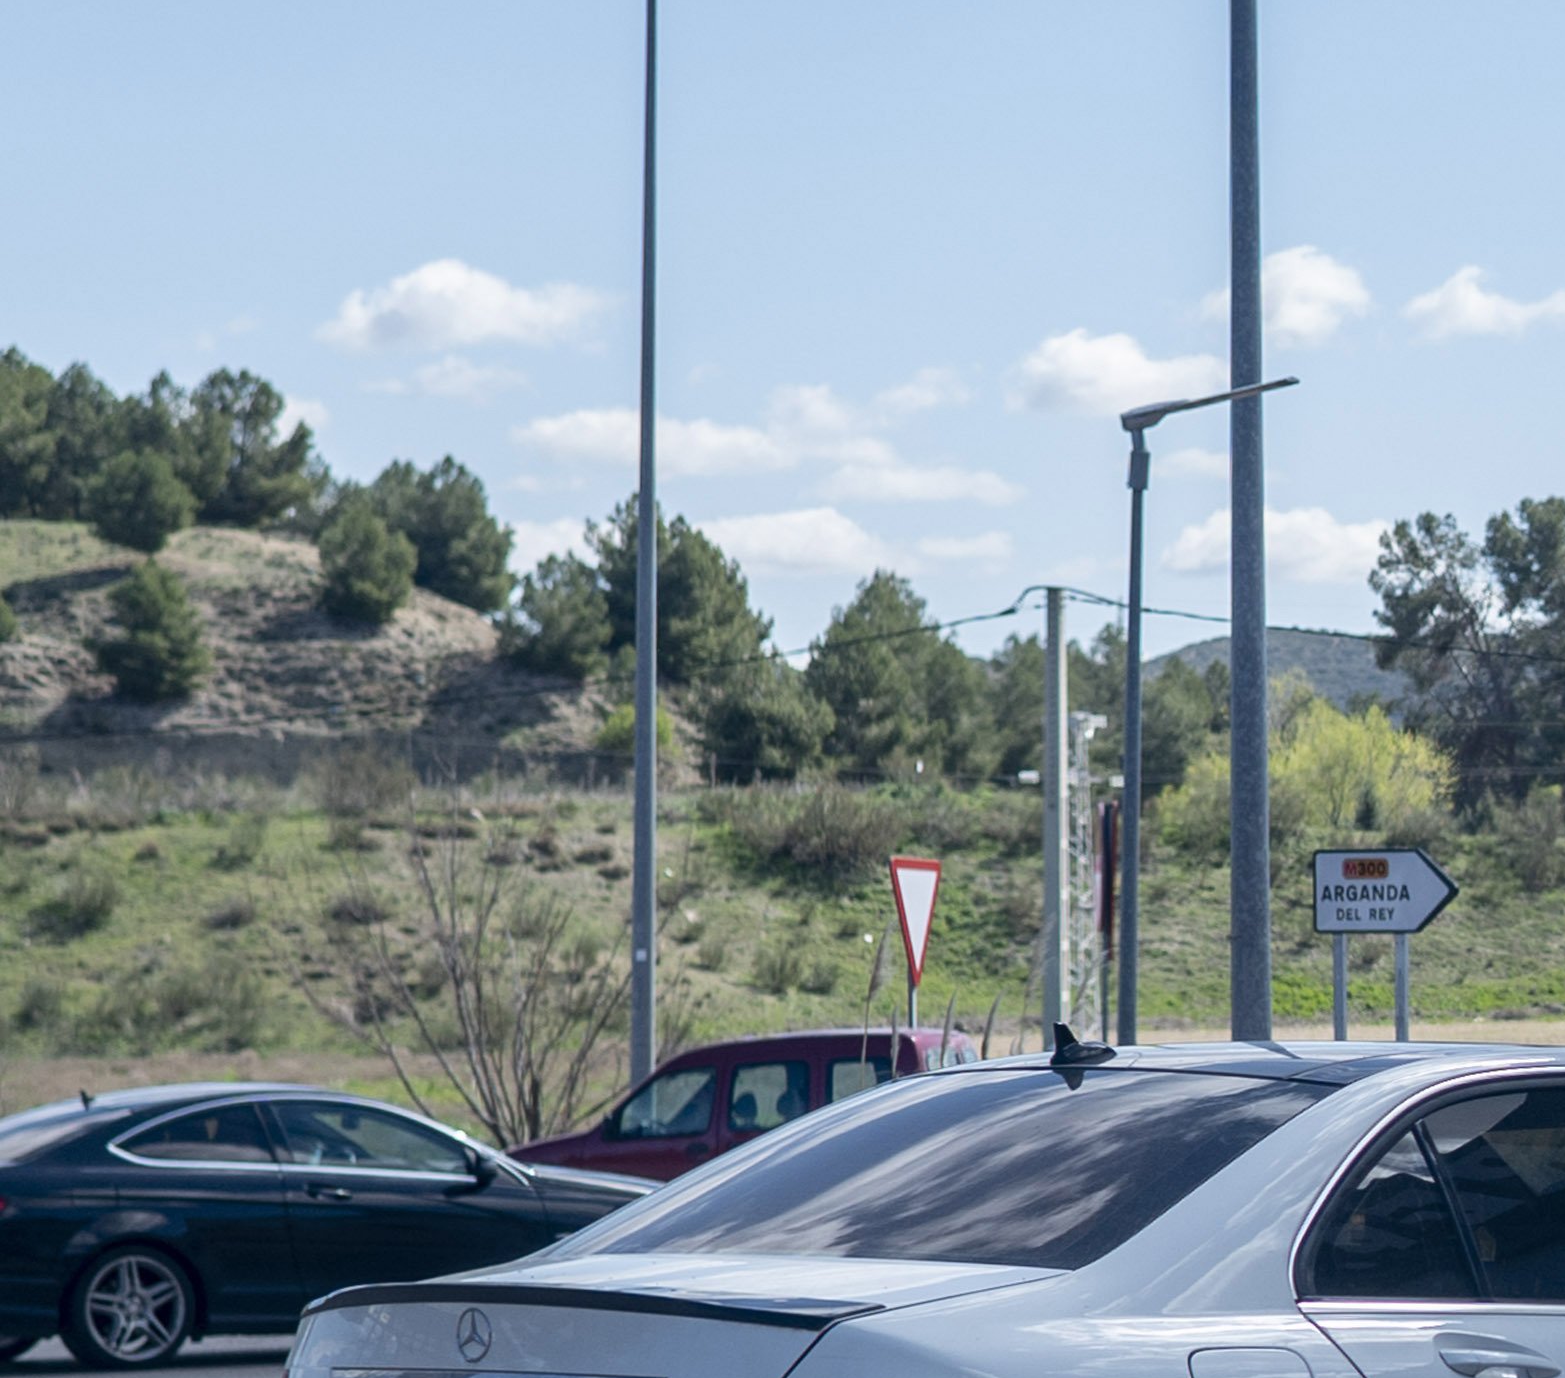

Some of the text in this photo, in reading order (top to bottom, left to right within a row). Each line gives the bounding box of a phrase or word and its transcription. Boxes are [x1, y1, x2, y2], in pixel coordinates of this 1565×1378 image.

[1320, 884, 1411, 902] ARGANDA
[1335, 907, 1396, 921] DEL REY
